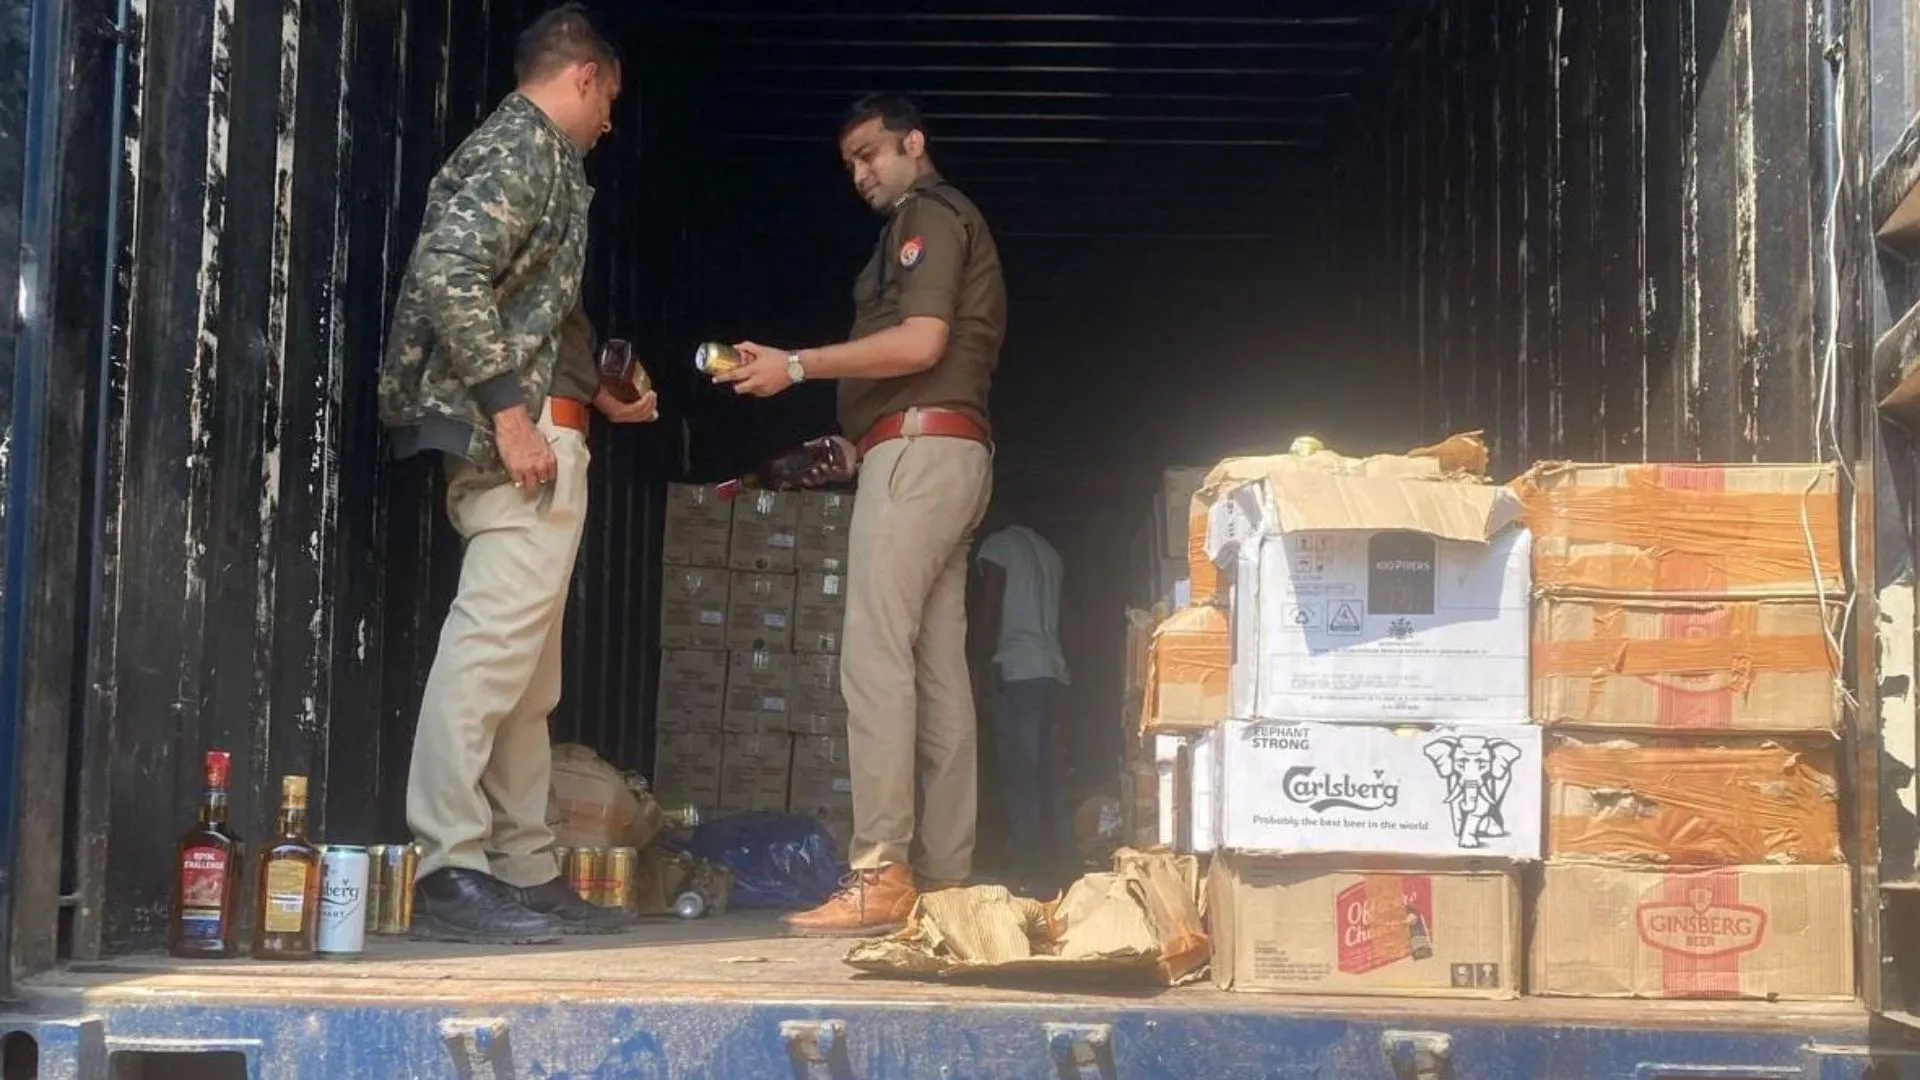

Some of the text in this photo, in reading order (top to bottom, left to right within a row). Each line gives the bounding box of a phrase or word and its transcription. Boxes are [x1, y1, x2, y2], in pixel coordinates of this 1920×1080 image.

[1252, 737, 1310, 750] STRONG
[1282, 765, 1400, 813] Carlsberg
[1253, 815, 1429, 832] Probably the best beer in the world
[1650, 914, 1753, 937] GINSBERG
[1685, 935, 1716, 948] BEER
